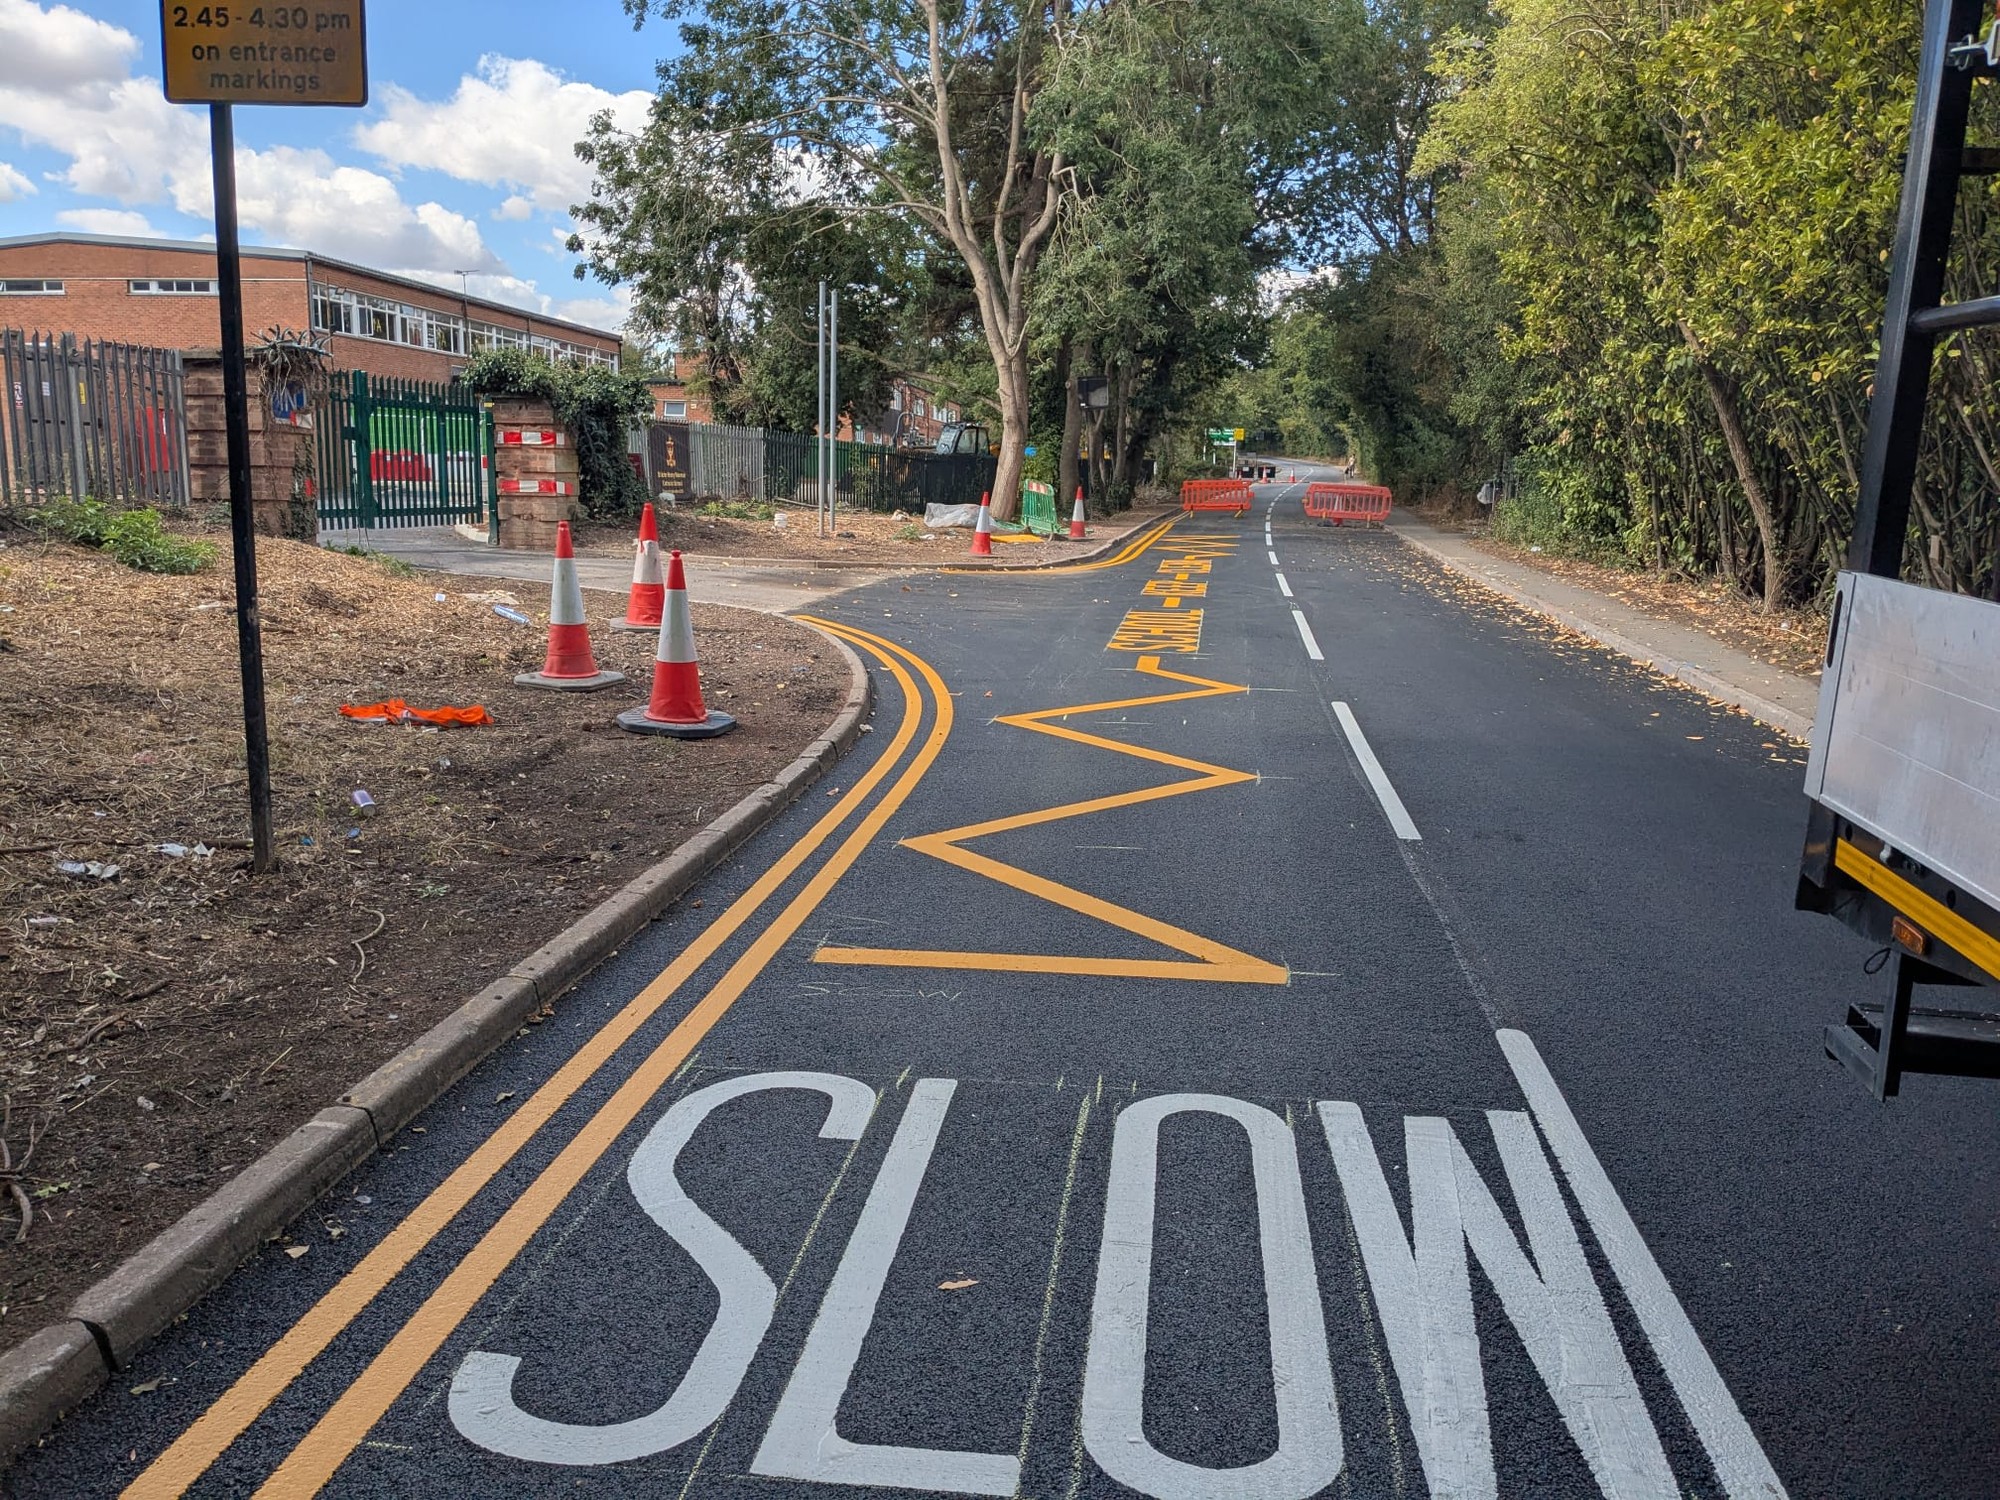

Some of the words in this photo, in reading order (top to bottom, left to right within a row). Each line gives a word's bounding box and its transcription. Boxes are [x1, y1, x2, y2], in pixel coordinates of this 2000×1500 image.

[173, 6, 229, 28] 2.45
[249, 7, 308, 30] 4.30
[315, 12, 350, 33] pm
[191, 44, 220, 61] on
[229, 42, 336, 63] entrance
[210, 69, 321, 94] markings
[1107, 609, 1202, 652] SCHOOL
[448, 1071, 1683, 1500] SLOW
